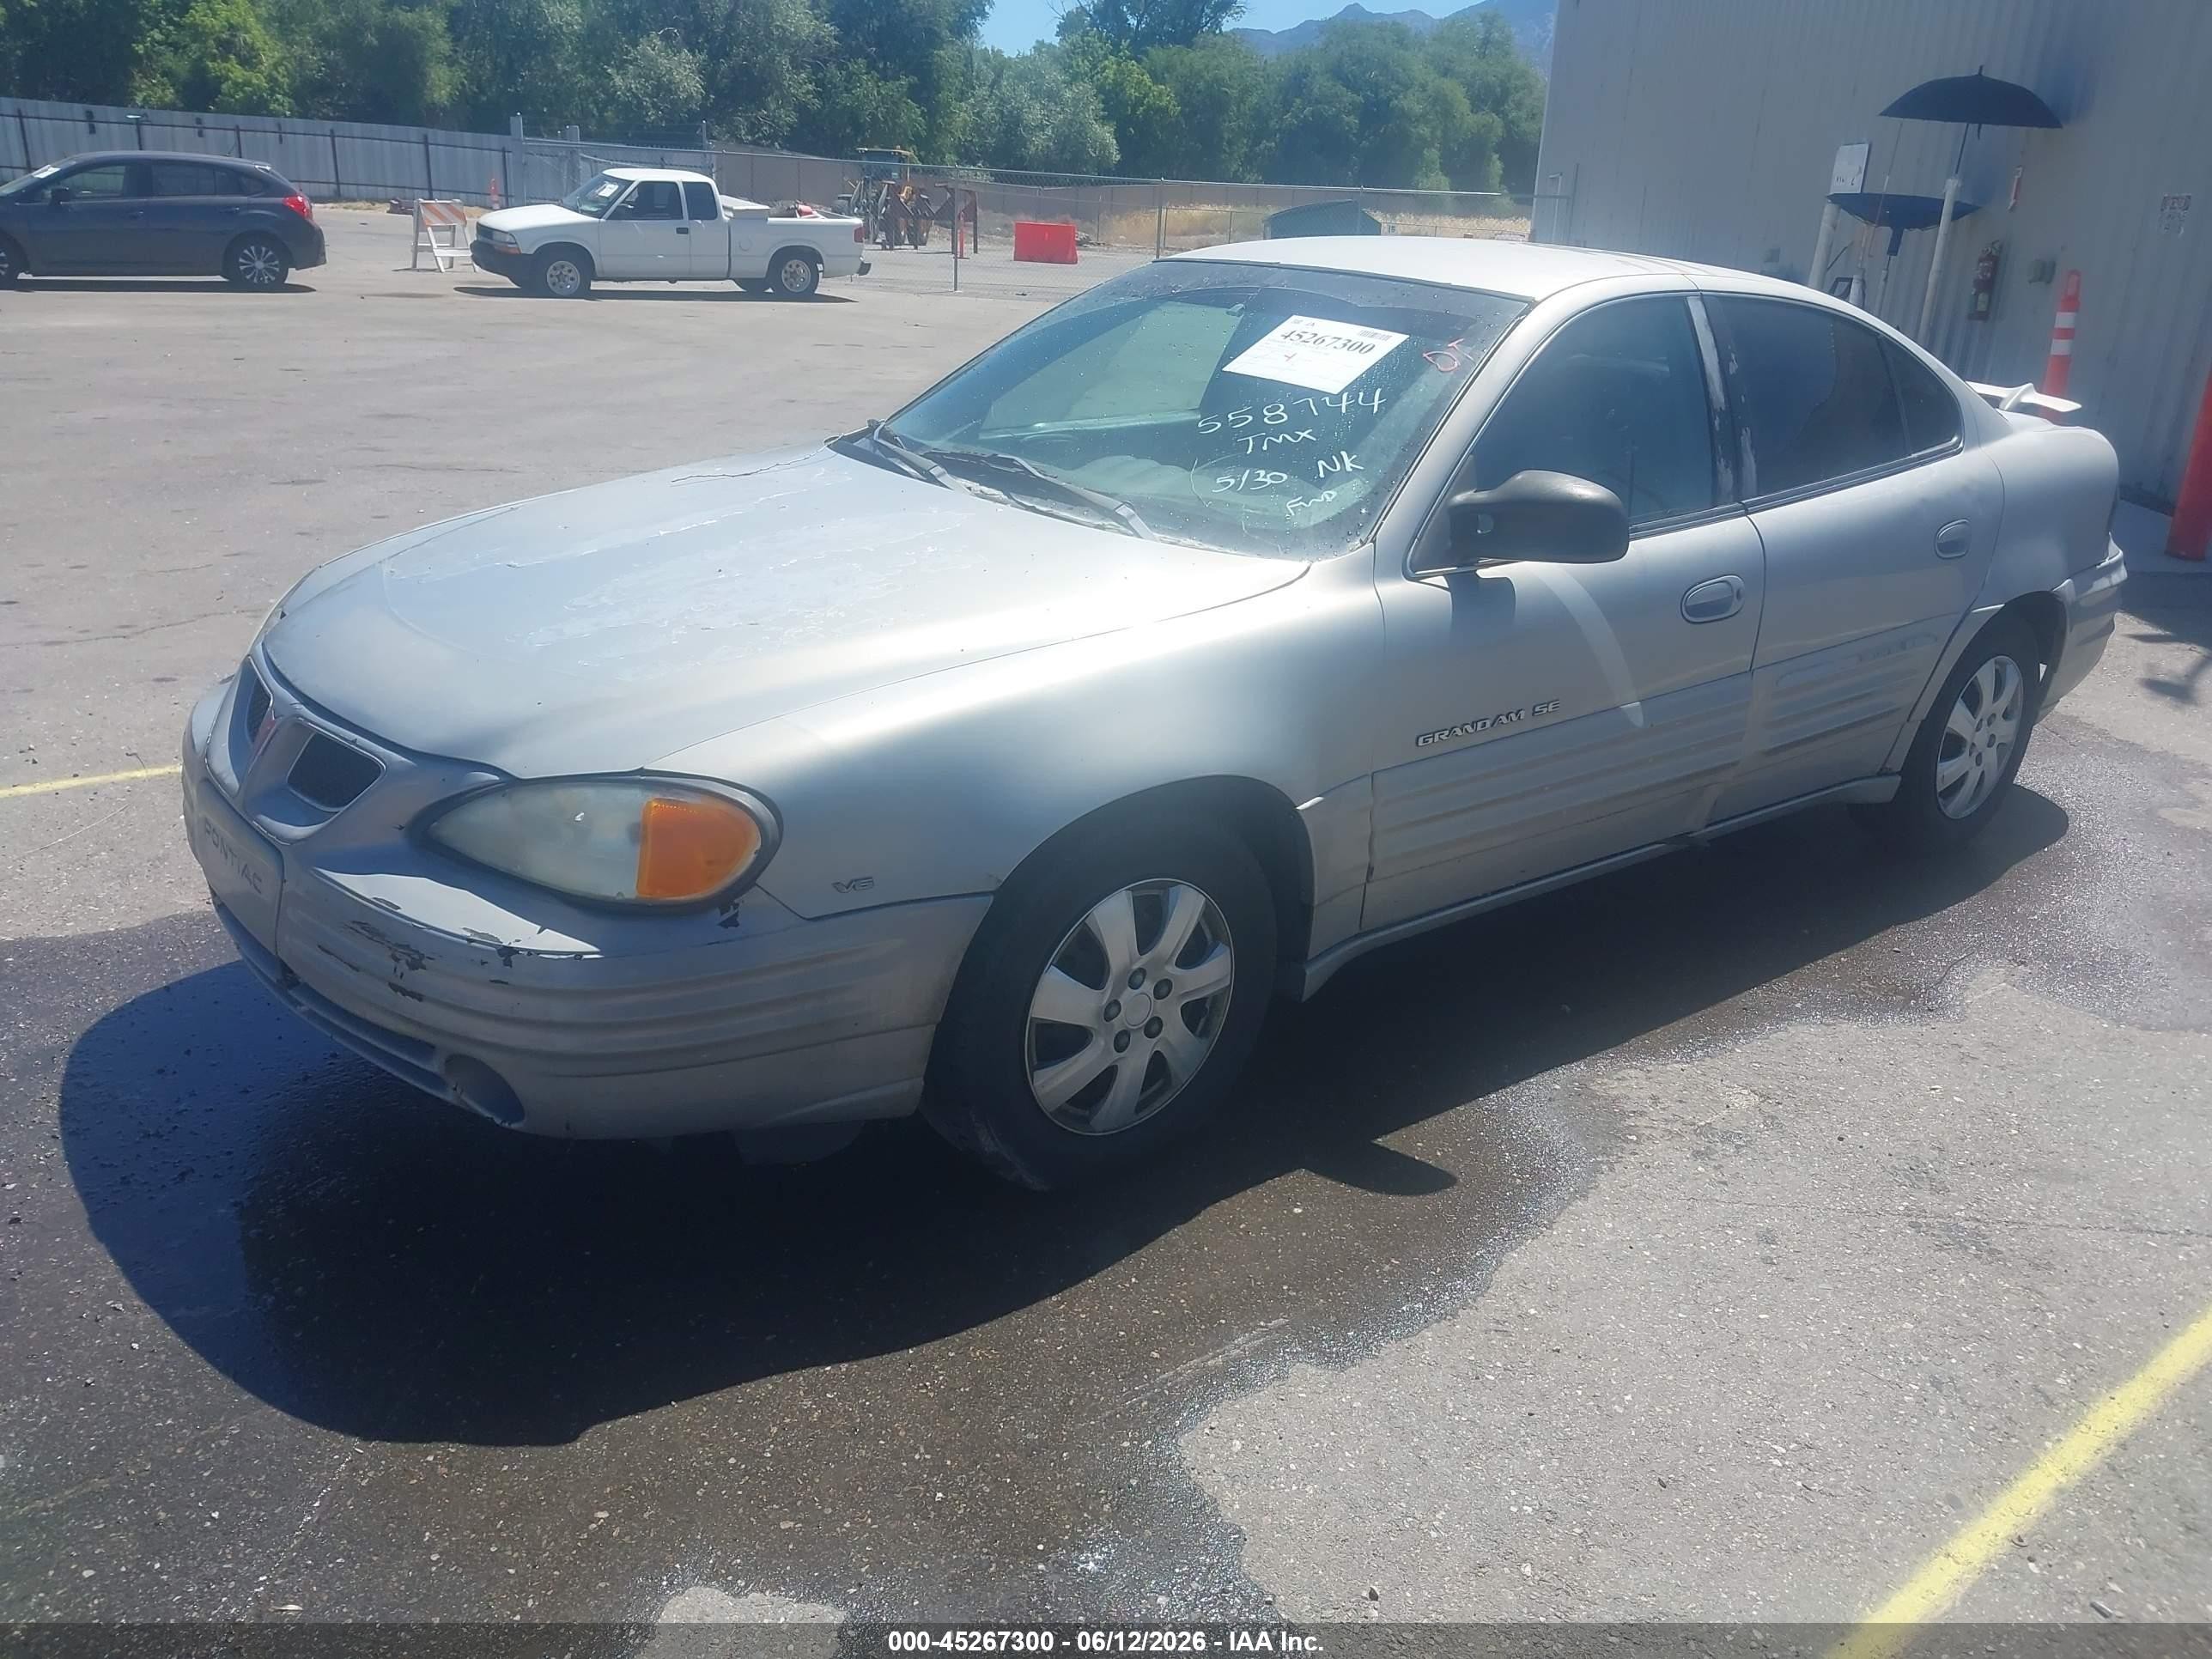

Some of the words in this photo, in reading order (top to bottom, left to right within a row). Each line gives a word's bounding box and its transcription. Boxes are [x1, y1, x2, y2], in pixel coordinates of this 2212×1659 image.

[1280, 330, 1376, 355] 45267300
[1417, 717, 1491, 747] GRAND
[1492, 708, 1526, 727] AM
[1533, 699, 1561, 716] SE
